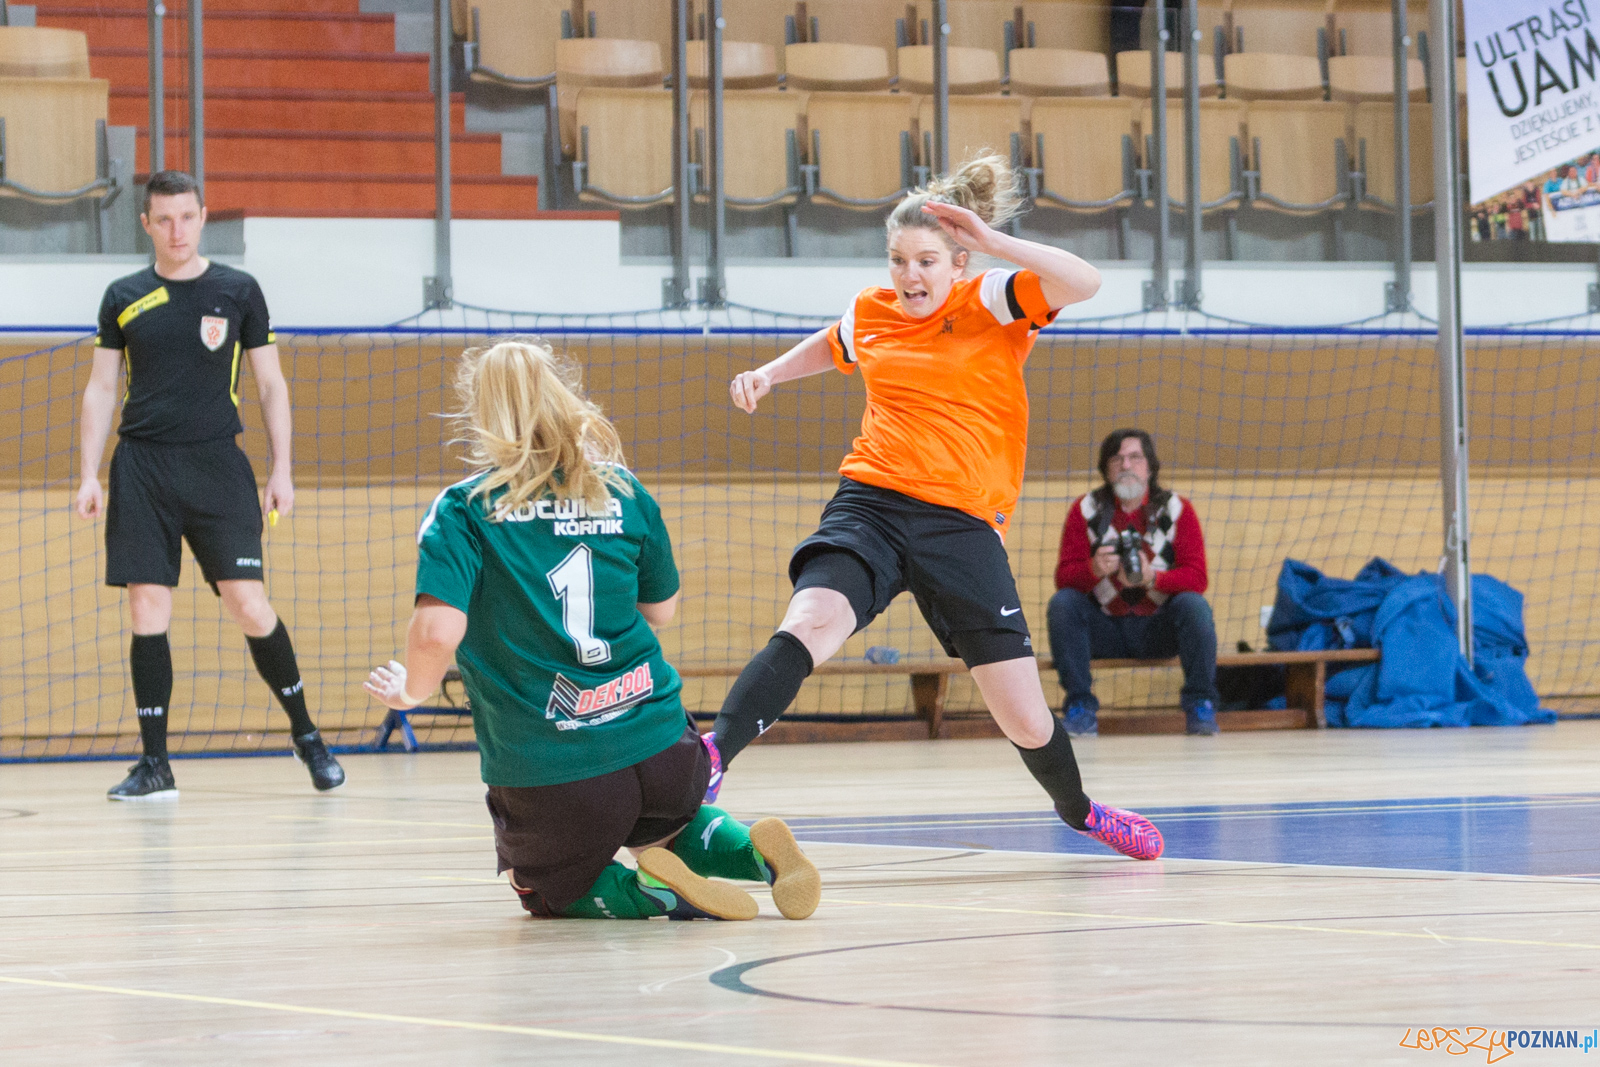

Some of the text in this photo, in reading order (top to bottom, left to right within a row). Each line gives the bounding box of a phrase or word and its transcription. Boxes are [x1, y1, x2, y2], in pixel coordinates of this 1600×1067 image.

[1473, 0, 1591, 68] ULTRASI
[1486, 27, 1600, 119] UAM
[1513, 121, 1581, 165] JESTEŚCIE
[545, 542, 612, 667] 1
